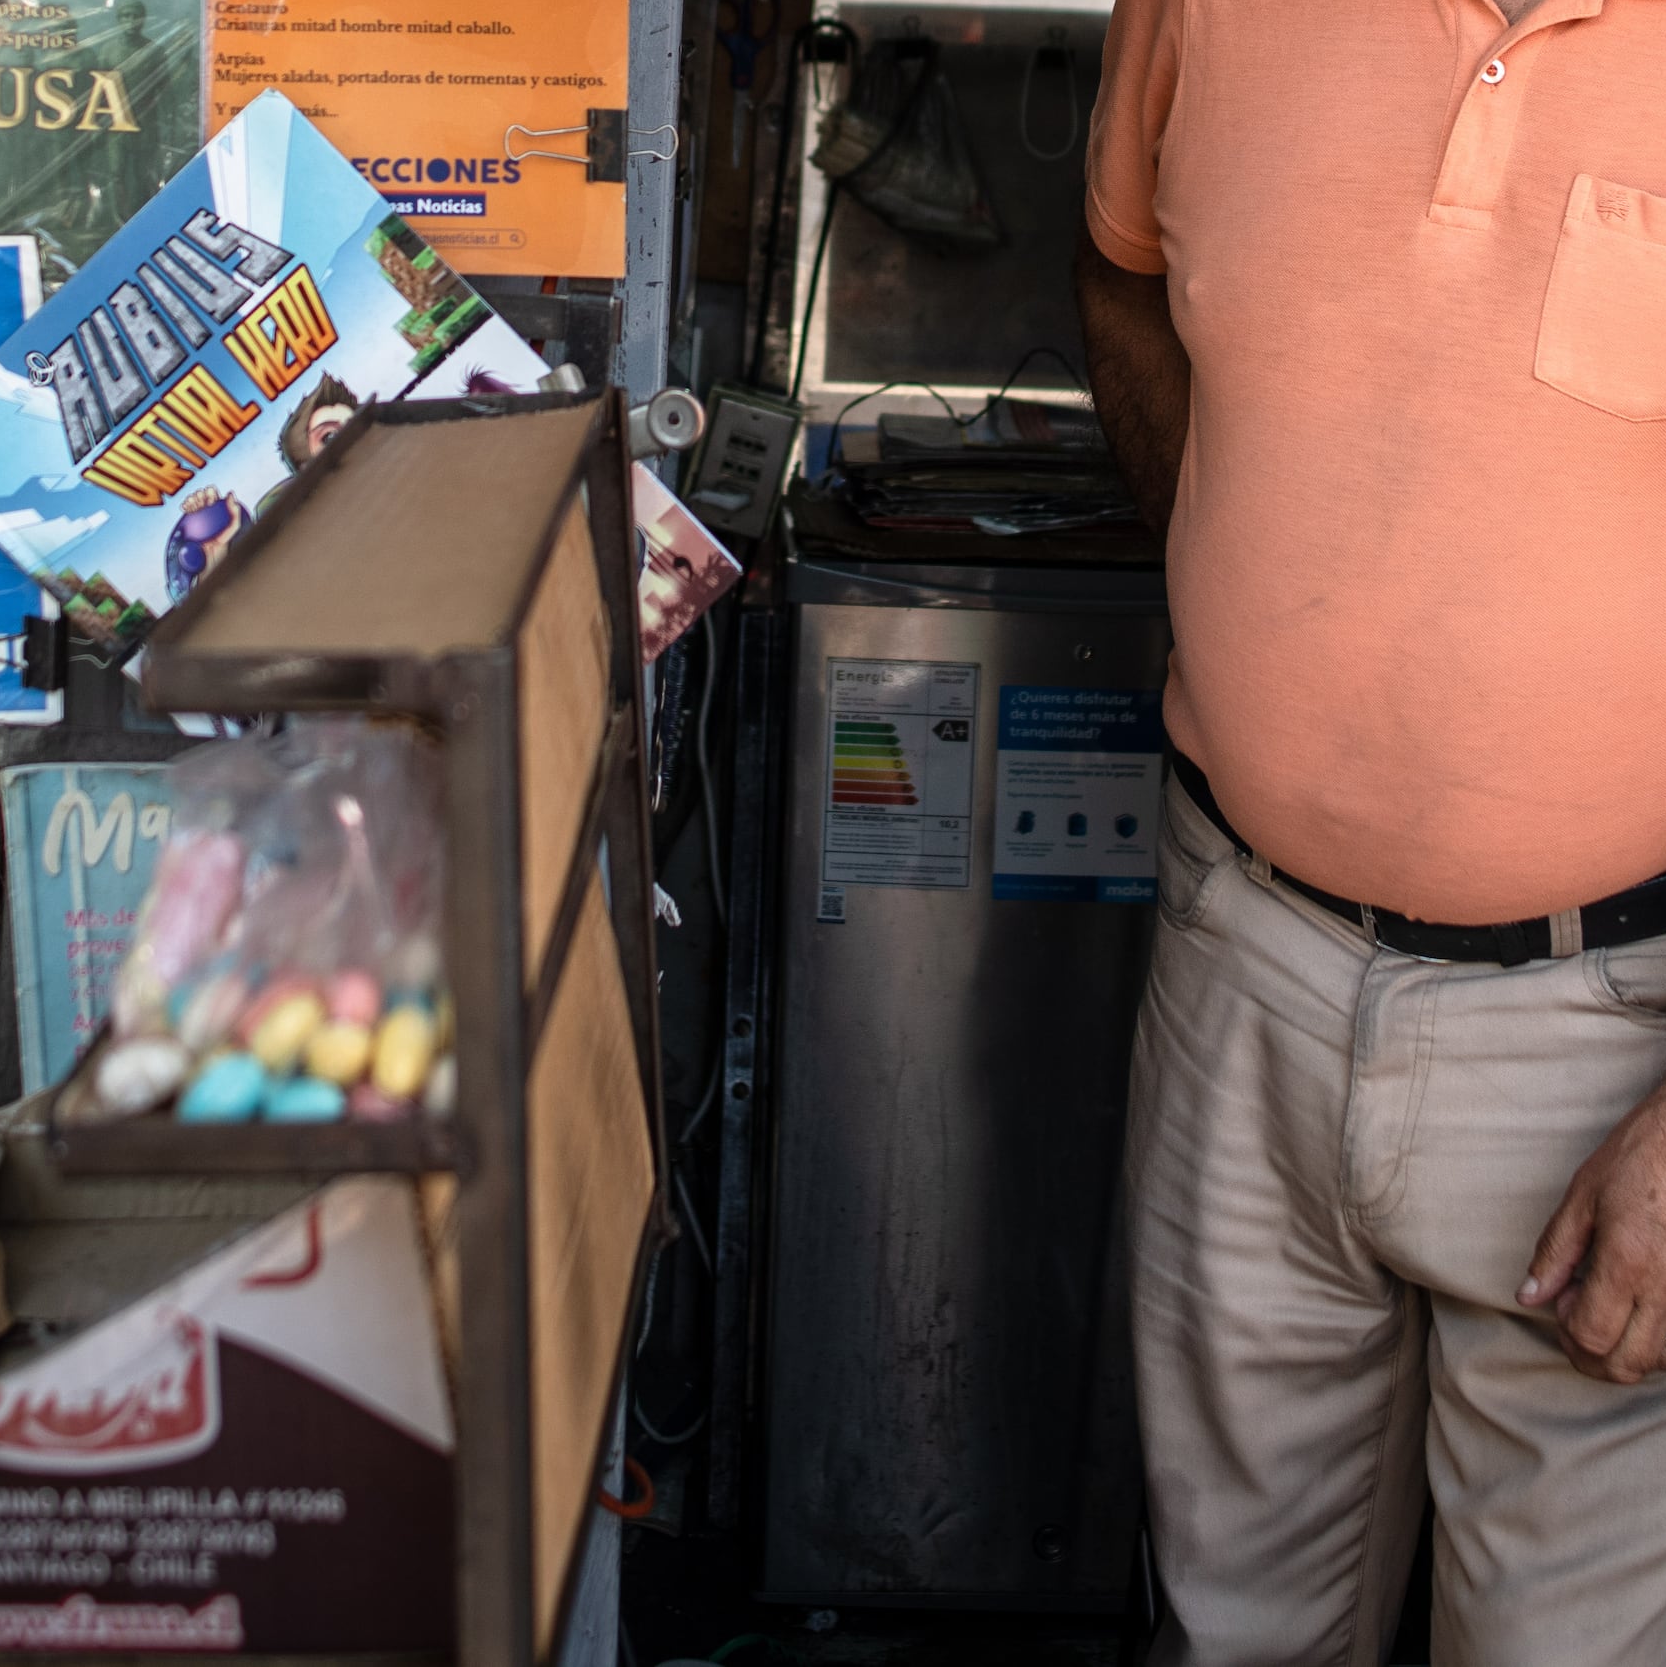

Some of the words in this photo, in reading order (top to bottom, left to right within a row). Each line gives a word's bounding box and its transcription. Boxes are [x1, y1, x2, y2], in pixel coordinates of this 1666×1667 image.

[46, 207, 295, 465] RUBIUS
[221, 262, 339, 402] HERO
[81, 361, 262, 507] VIRTUAL
[940, 721, 969, 740] A+
[1010, 691, 1071, 707] ¿Quieres
[1073, 692, 1134, 706] disfrutar
